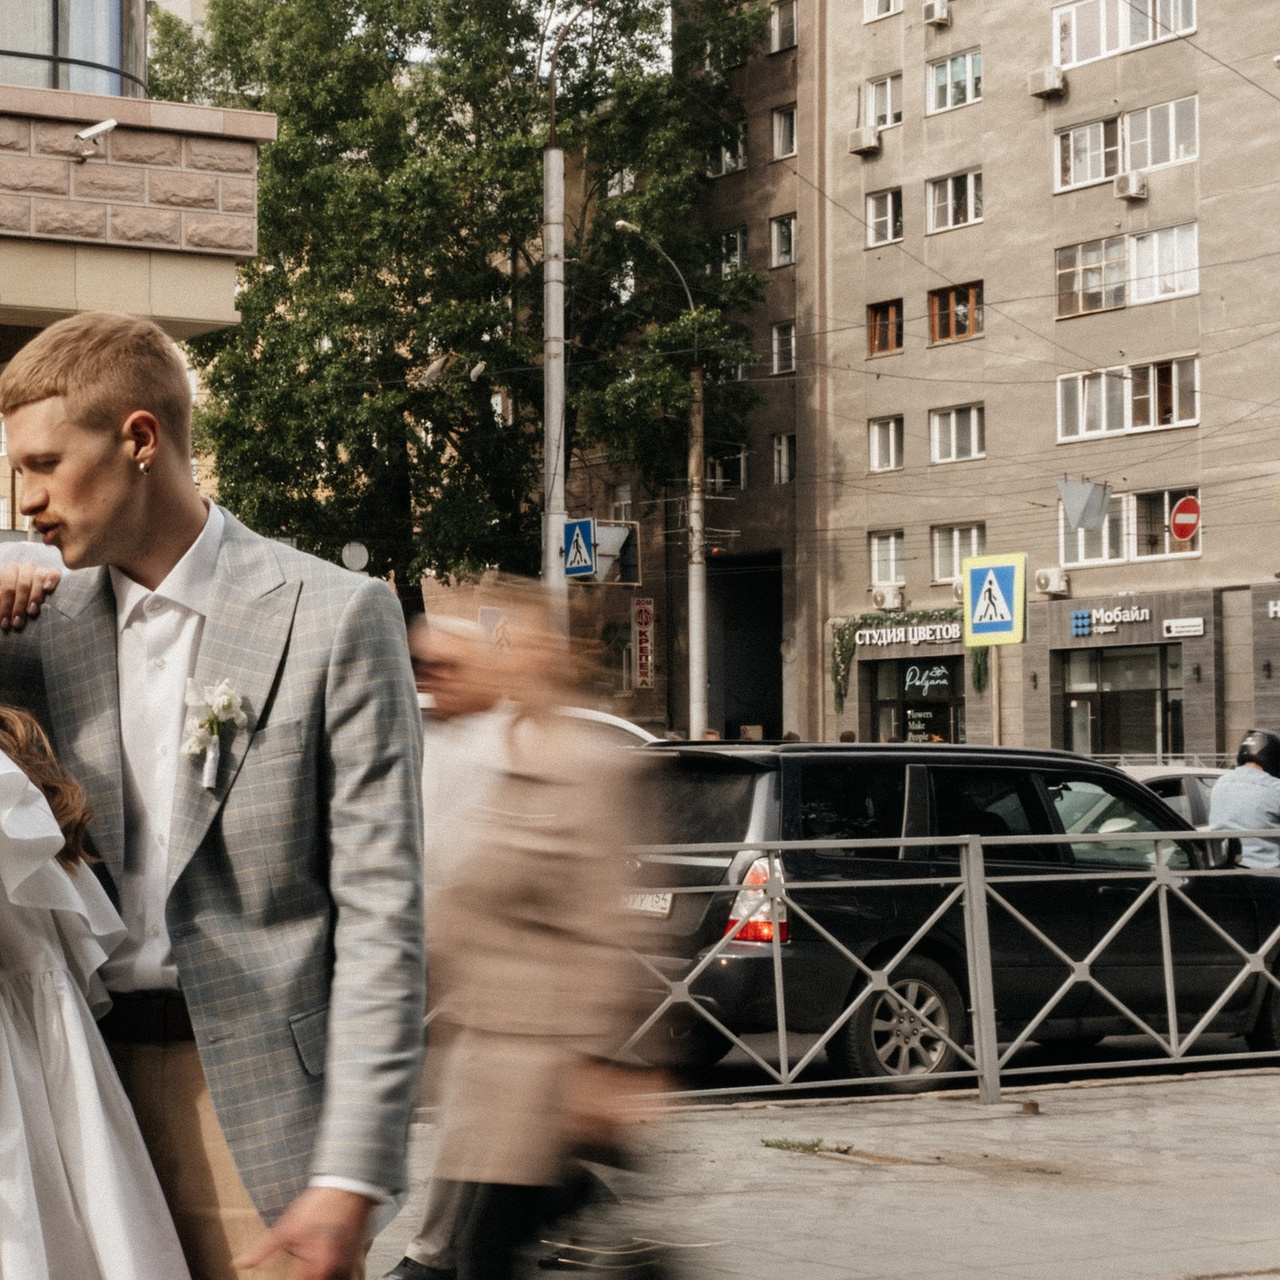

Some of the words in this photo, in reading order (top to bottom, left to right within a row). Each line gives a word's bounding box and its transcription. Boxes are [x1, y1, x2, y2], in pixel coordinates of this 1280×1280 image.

[1091, 606, 1150, 624] Мобайл
[855, 628, 905, 646] СТУДИЯ
[908, 624, 960, 644] ЦВЕТОВ
[639, 630, 649, 686] КРЕПЕЖА
[904, 666, 949, 697] Polyana
[908, 721, 925, 729] Make
[908, 731, 929, 743] People
